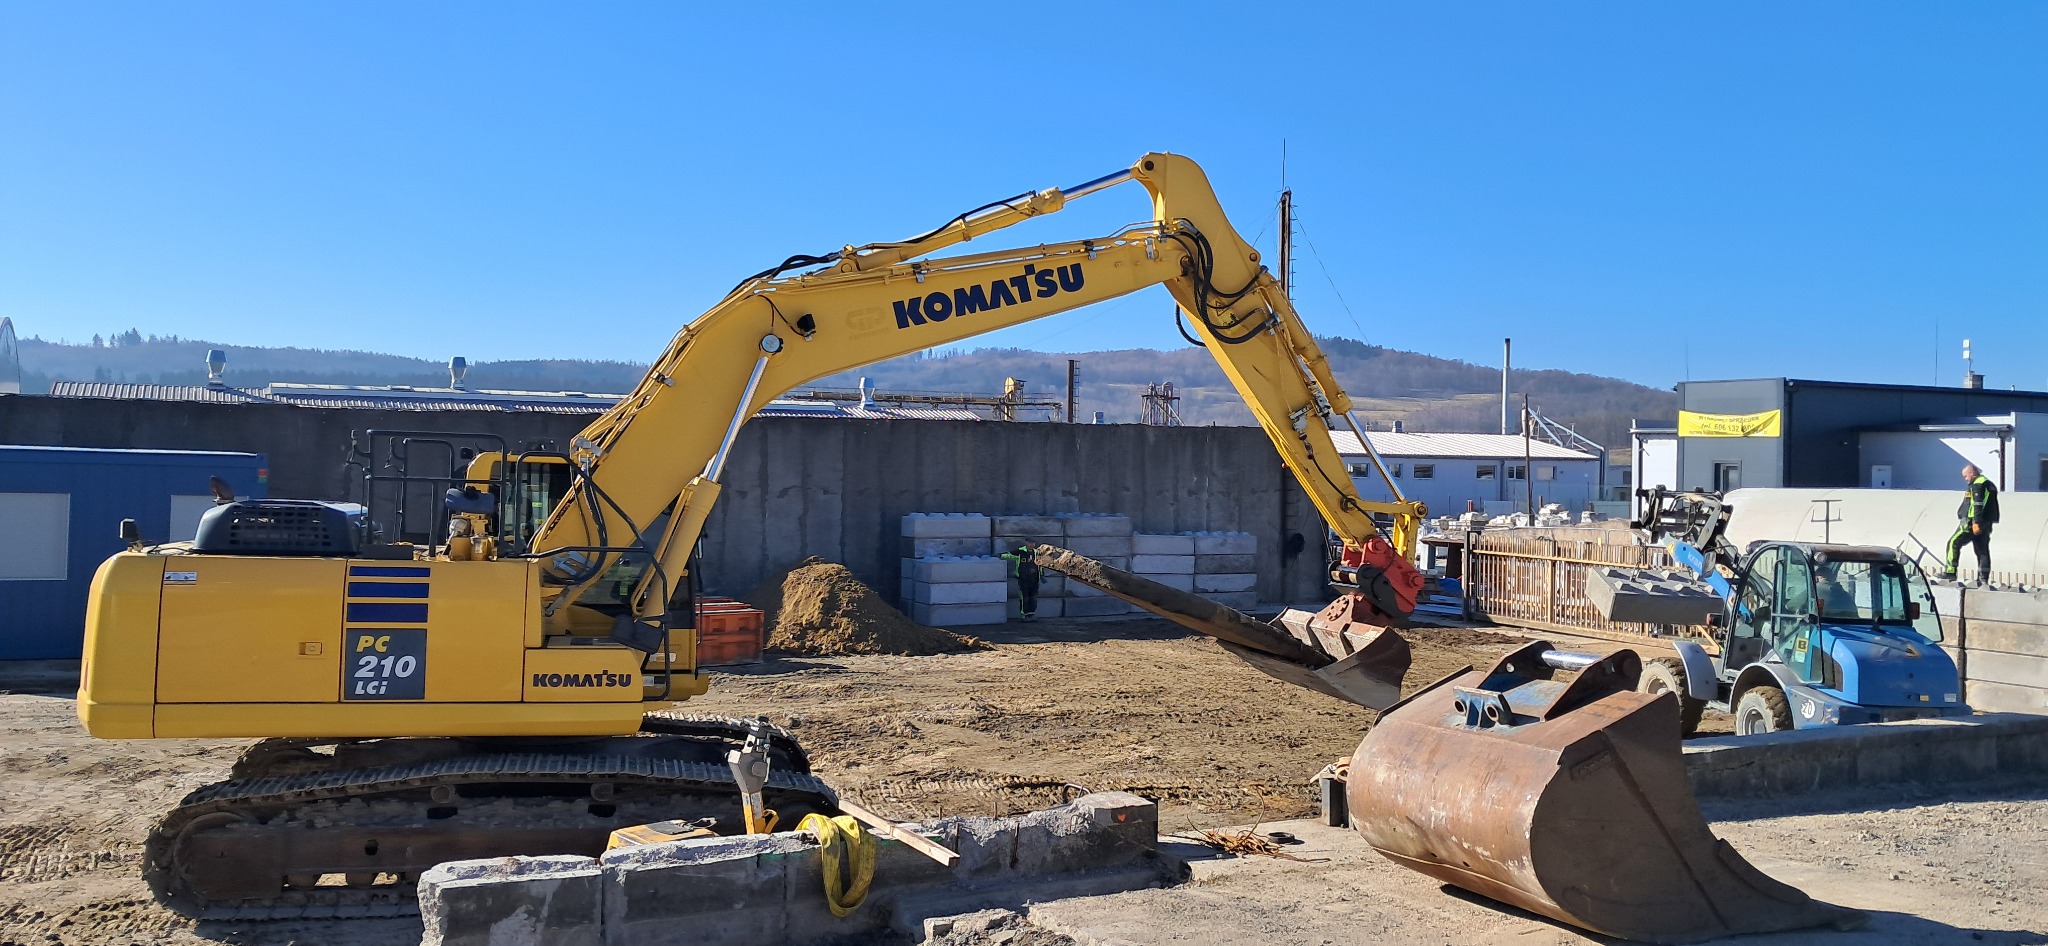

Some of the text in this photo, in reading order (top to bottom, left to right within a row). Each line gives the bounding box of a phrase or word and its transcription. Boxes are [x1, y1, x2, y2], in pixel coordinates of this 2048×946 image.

[892, 262, 1085, 330] KOMATSU
[355, 635, 391, 653] PC
[1798, 640, 1807, 650] B
[353, 655, 417, 678] 210
[532, 669, 632, 688] KOMATSU
[354, 681, 388, 695] LCi
